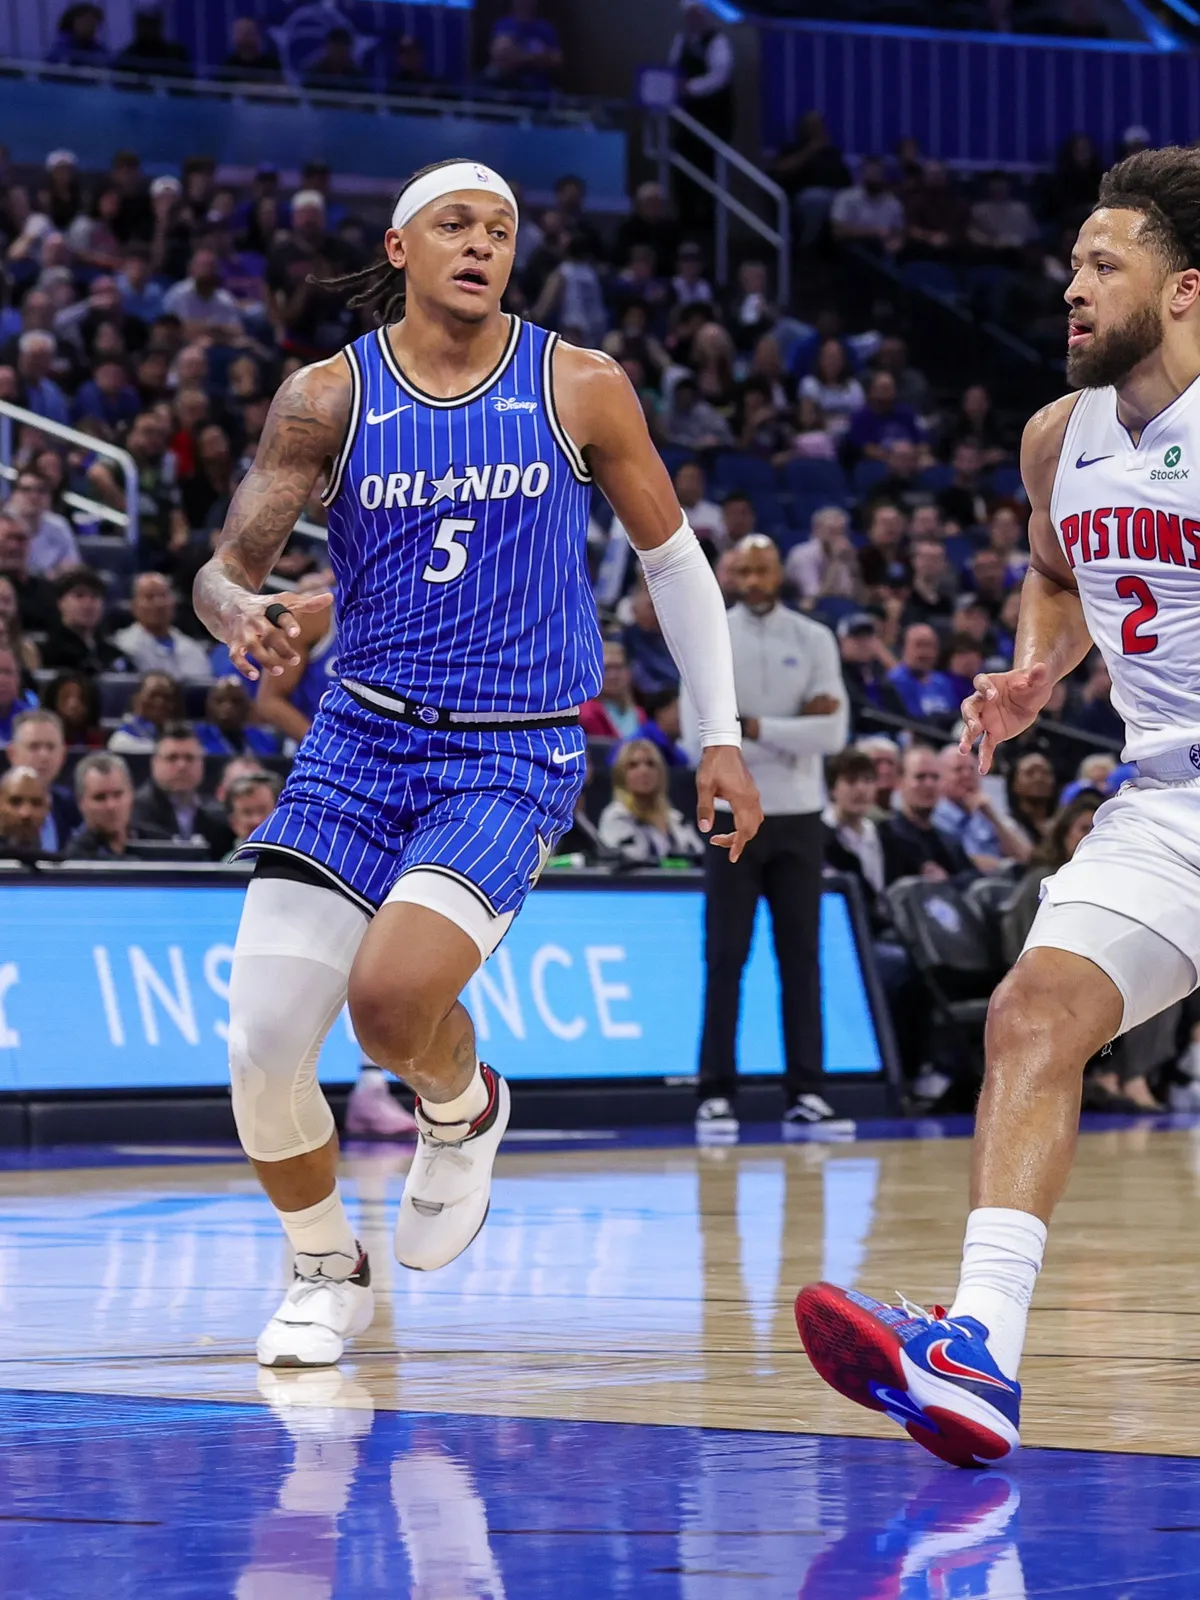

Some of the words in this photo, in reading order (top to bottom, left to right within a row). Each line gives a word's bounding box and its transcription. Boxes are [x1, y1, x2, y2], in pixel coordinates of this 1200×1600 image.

[490, 397, 538, 414] Disney
[1150, 469, 1190, 480] StockX
[421, 517, 477, 584] 5
[1115, 575, 1159, 656] 2
[93, 944, 642, 1046] INSNCE
